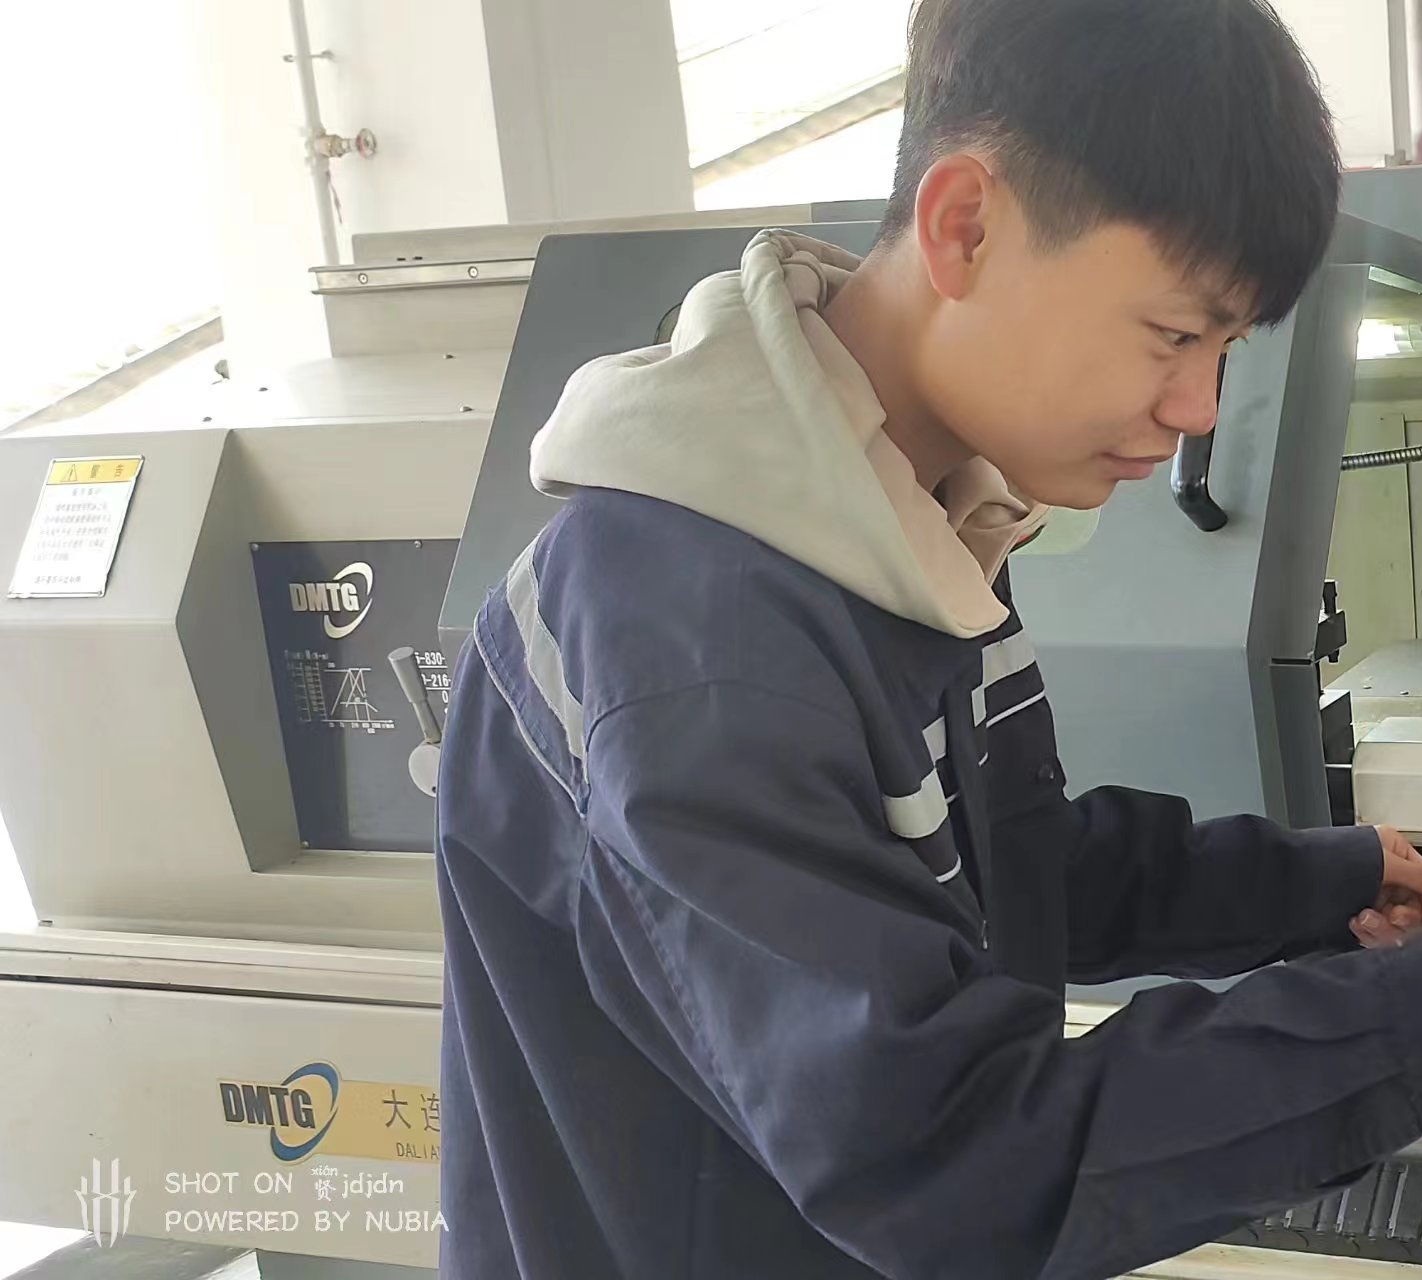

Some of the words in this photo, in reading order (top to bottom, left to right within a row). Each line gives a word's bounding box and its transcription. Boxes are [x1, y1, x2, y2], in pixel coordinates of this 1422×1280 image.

[289, 582, 359, 611] DMTG
[219, 1083, 316, 1129] DMTG
[396, 1142, 440, 1160] DALIA
